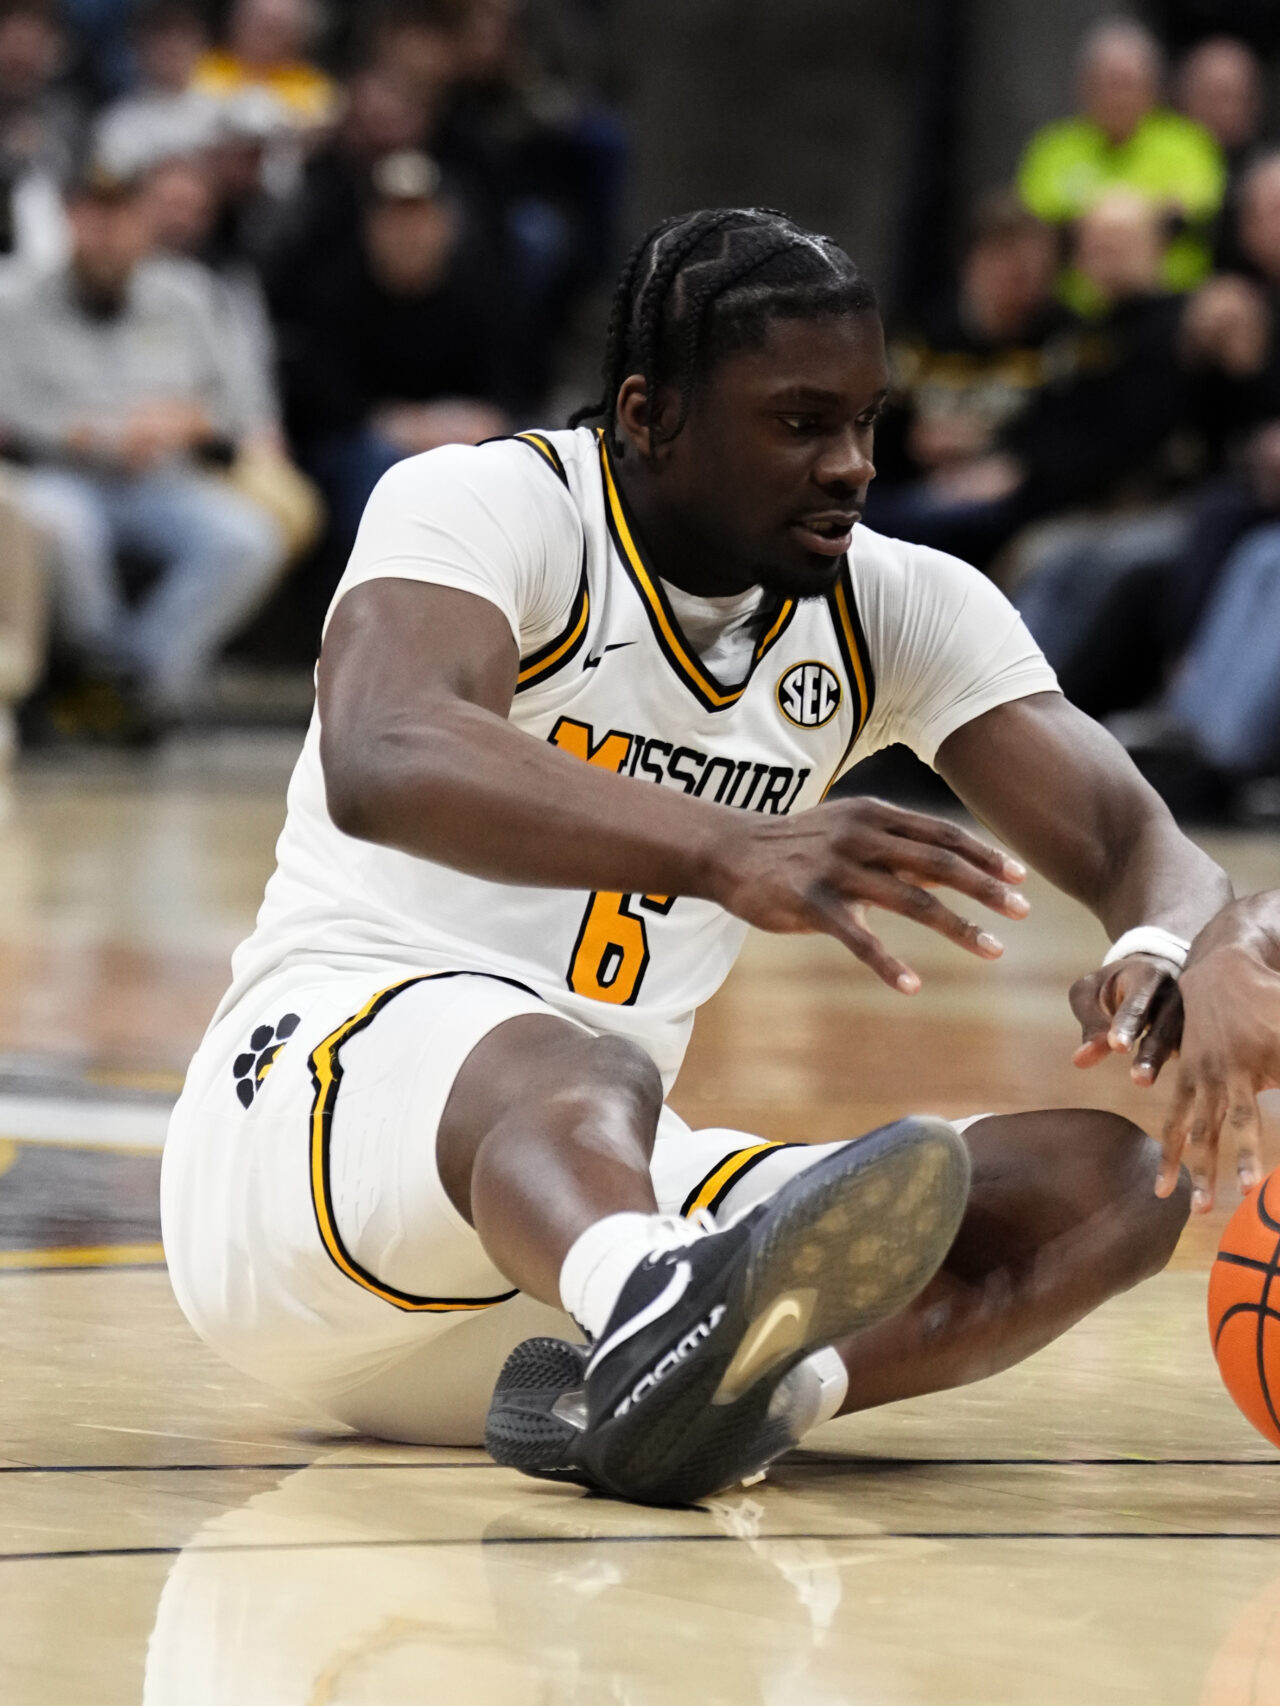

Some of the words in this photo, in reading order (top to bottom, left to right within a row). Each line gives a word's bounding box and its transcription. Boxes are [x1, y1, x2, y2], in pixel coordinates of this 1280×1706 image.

[782, 664, 839, 726] SEC
[547, 715, 811, 816] MISSOURI
[566, 889, 678, 1007] 6
